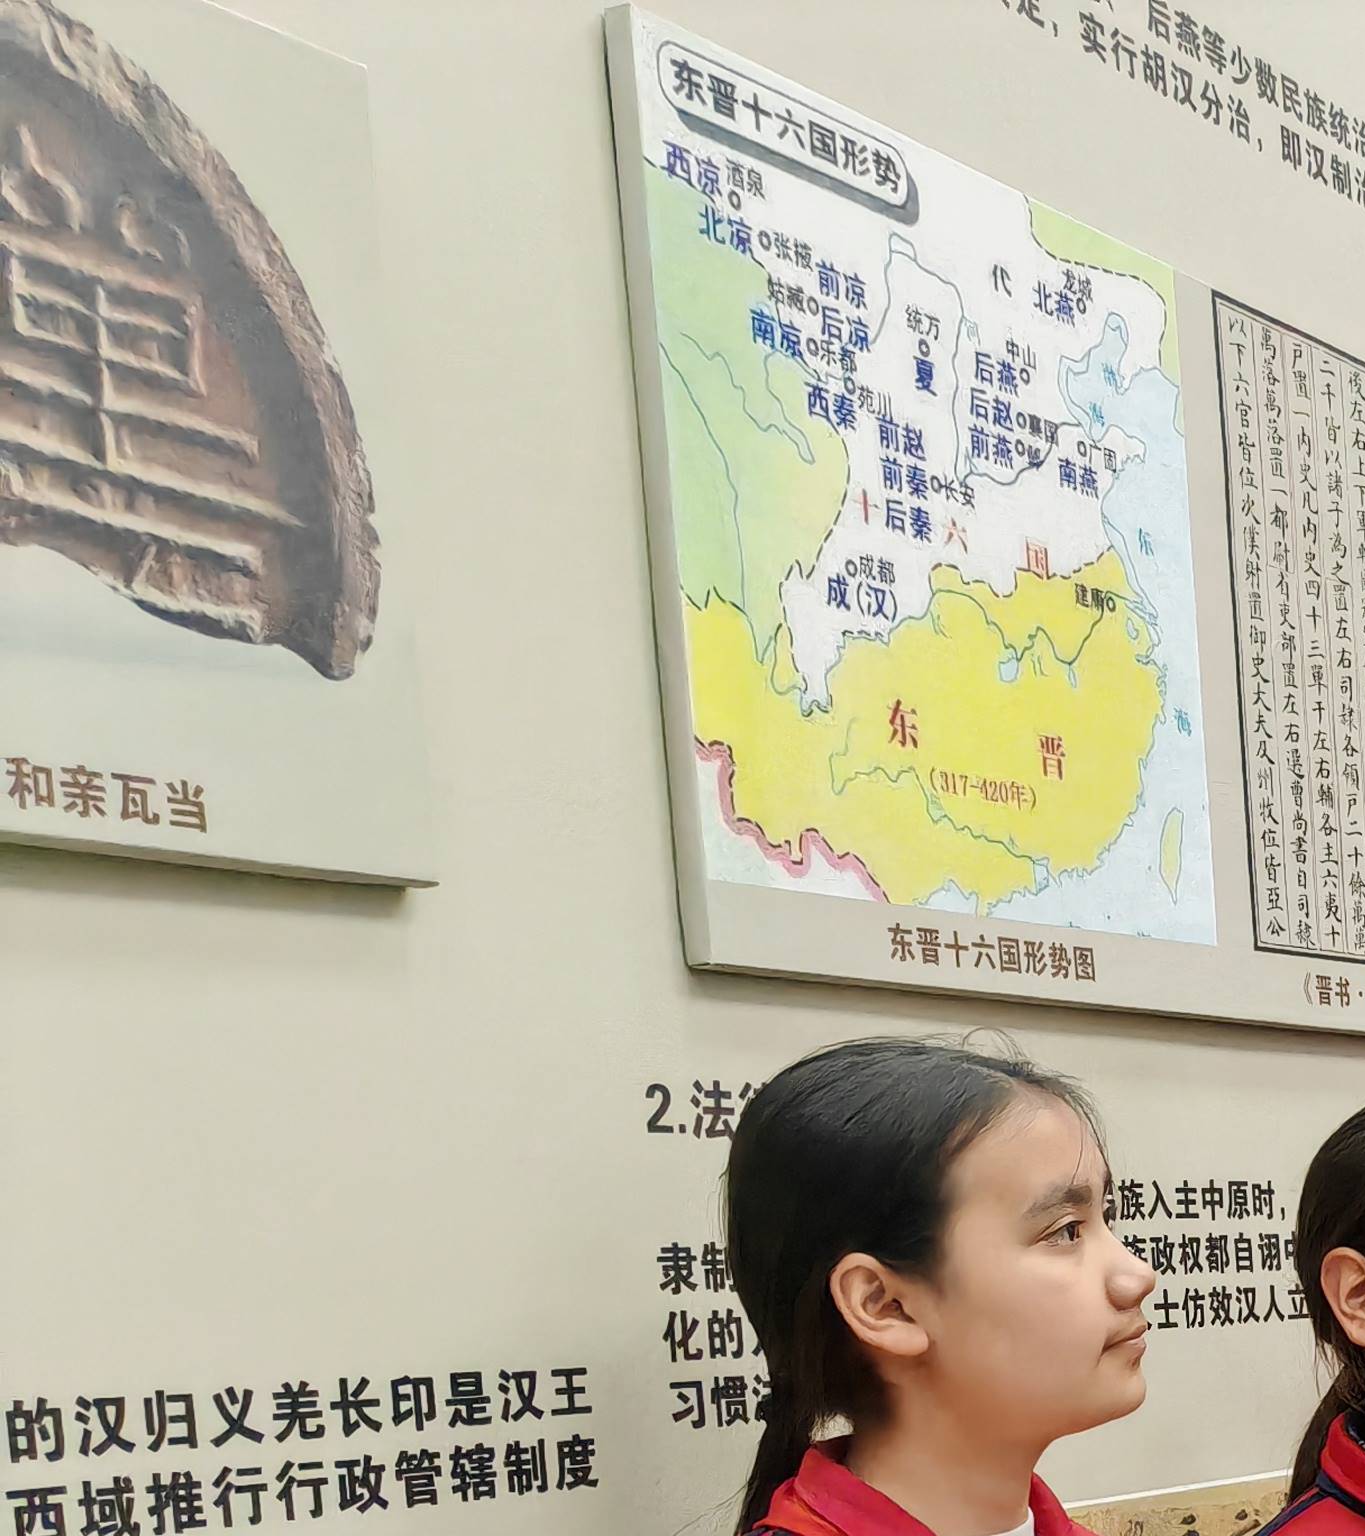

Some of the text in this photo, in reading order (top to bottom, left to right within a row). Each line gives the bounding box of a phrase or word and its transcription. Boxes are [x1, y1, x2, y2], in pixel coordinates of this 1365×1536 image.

[670, 58, 902, 193] 东晋十六国形势
[663, 140, 722, 198] 西凉
[698, 204, 752, 254] 北凉
[816, 260, 867, 311] 前凉
[1033, 280, 1076, 328] 北燕
[750, 308, 803, 358] 南凉
[821, 306, 872, 353] 后凉
[912, 355, 938, 397] 夏
[975, 351, 1019, 398] 后燕
[804, 381, 857, 432] 西秦
[970, 387, 1014, 432] 后赵
[876, 414, 926, 461] 前赵
[968, 423, 1013, 470] 前燕
[880, 456, 929, 501] 前秦
[1058, 457, 1100, 500] 南燕
[885, 498, 933, 544] 后秦
[887, 699, 1066, 781] 东 晋
[4, 757, 208, 834] 和亲瓦当
[888, 922, 1096, 982] 东晋十六国形势图
[645, 1079, 768, 1140] 2.法
[5, 1367, 594, 1464] 的汉归义羌长印是汉王
